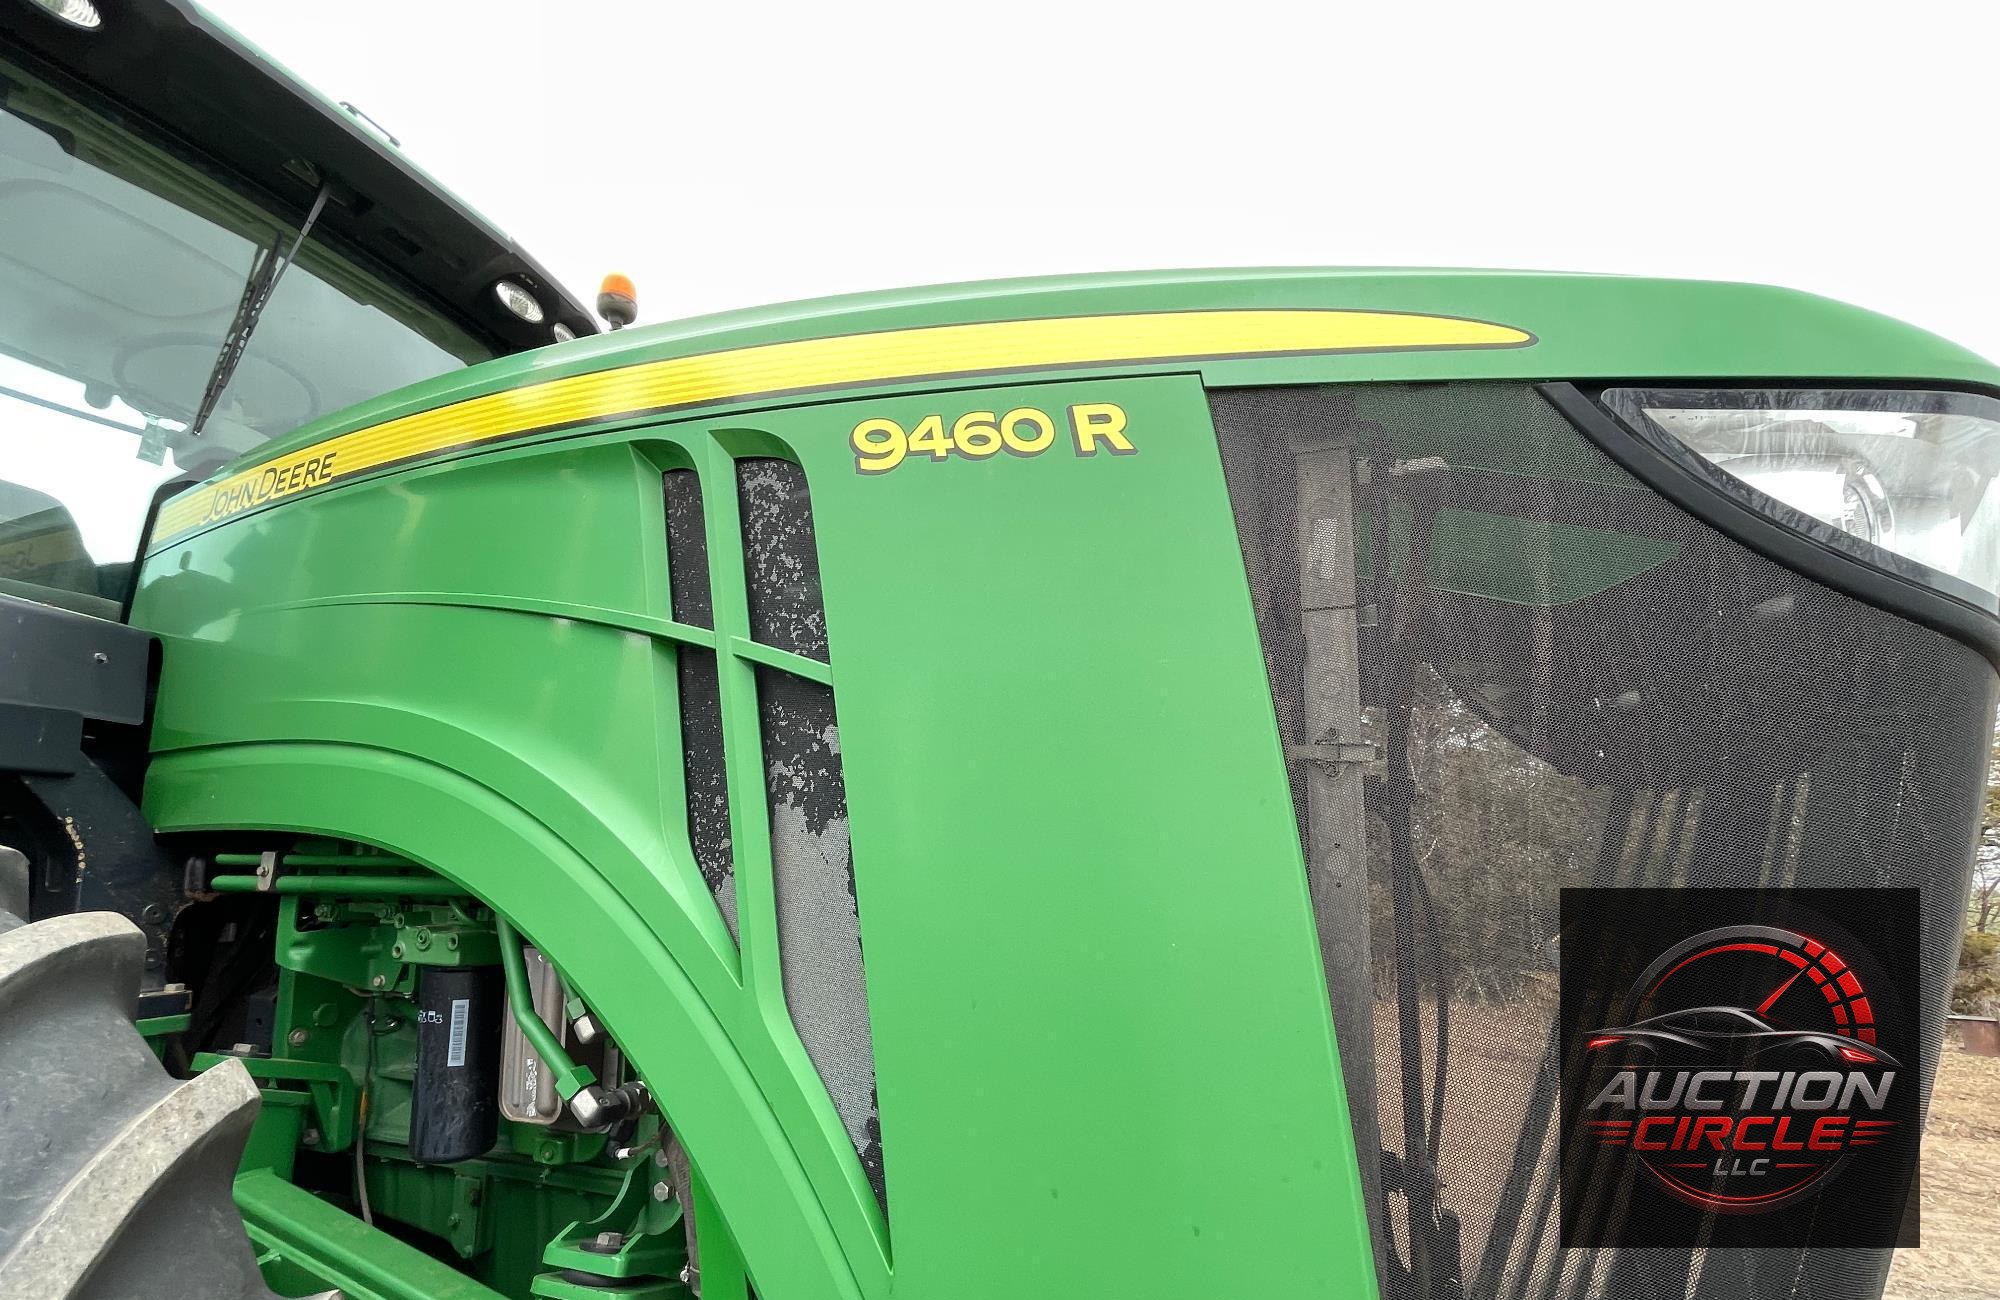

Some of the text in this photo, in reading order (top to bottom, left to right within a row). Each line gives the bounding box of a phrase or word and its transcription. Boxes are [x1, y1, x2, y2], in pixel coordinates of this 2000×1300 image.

[850, 402, 1138, 475] 9460 R
[202, 453, 337, 521] JOHN DEERE
